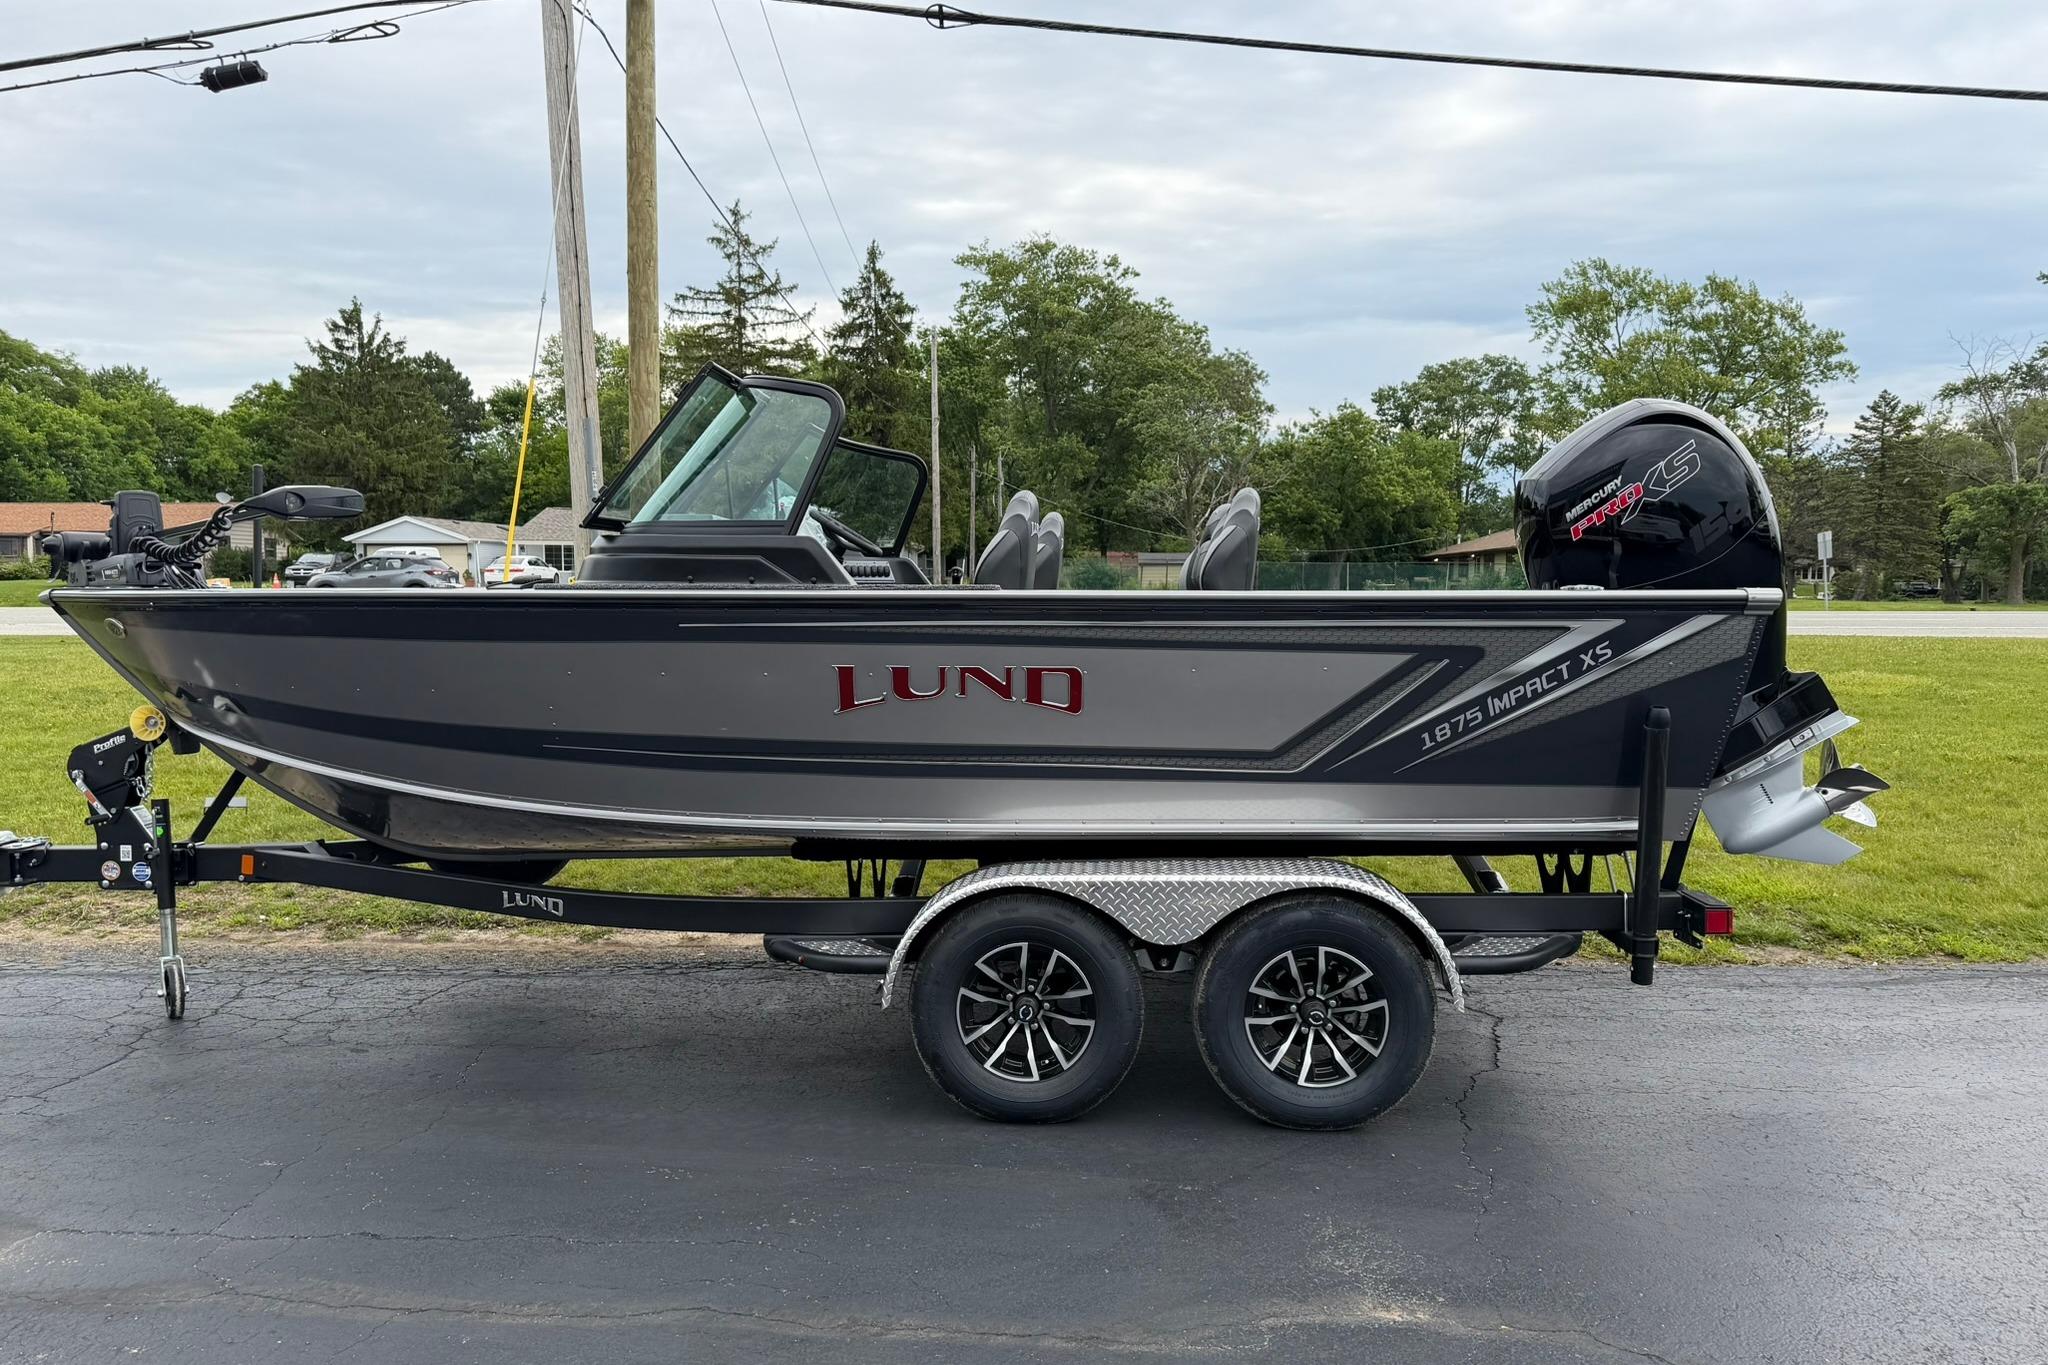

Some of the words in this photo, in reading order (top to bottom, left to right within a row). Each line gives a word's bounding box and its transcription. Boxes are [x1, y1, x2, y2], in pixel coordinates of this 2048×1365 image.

[1565, 474, 1623, 523] MERCURY
[832, 664, 1085, 716] LUND
[1421, 705, 1483, 751] 1875
[1487, 660, 1572, 717] IMPACT
[1579, 640, 1613, 672] XS
[502, 890, 564, 917] LUND
